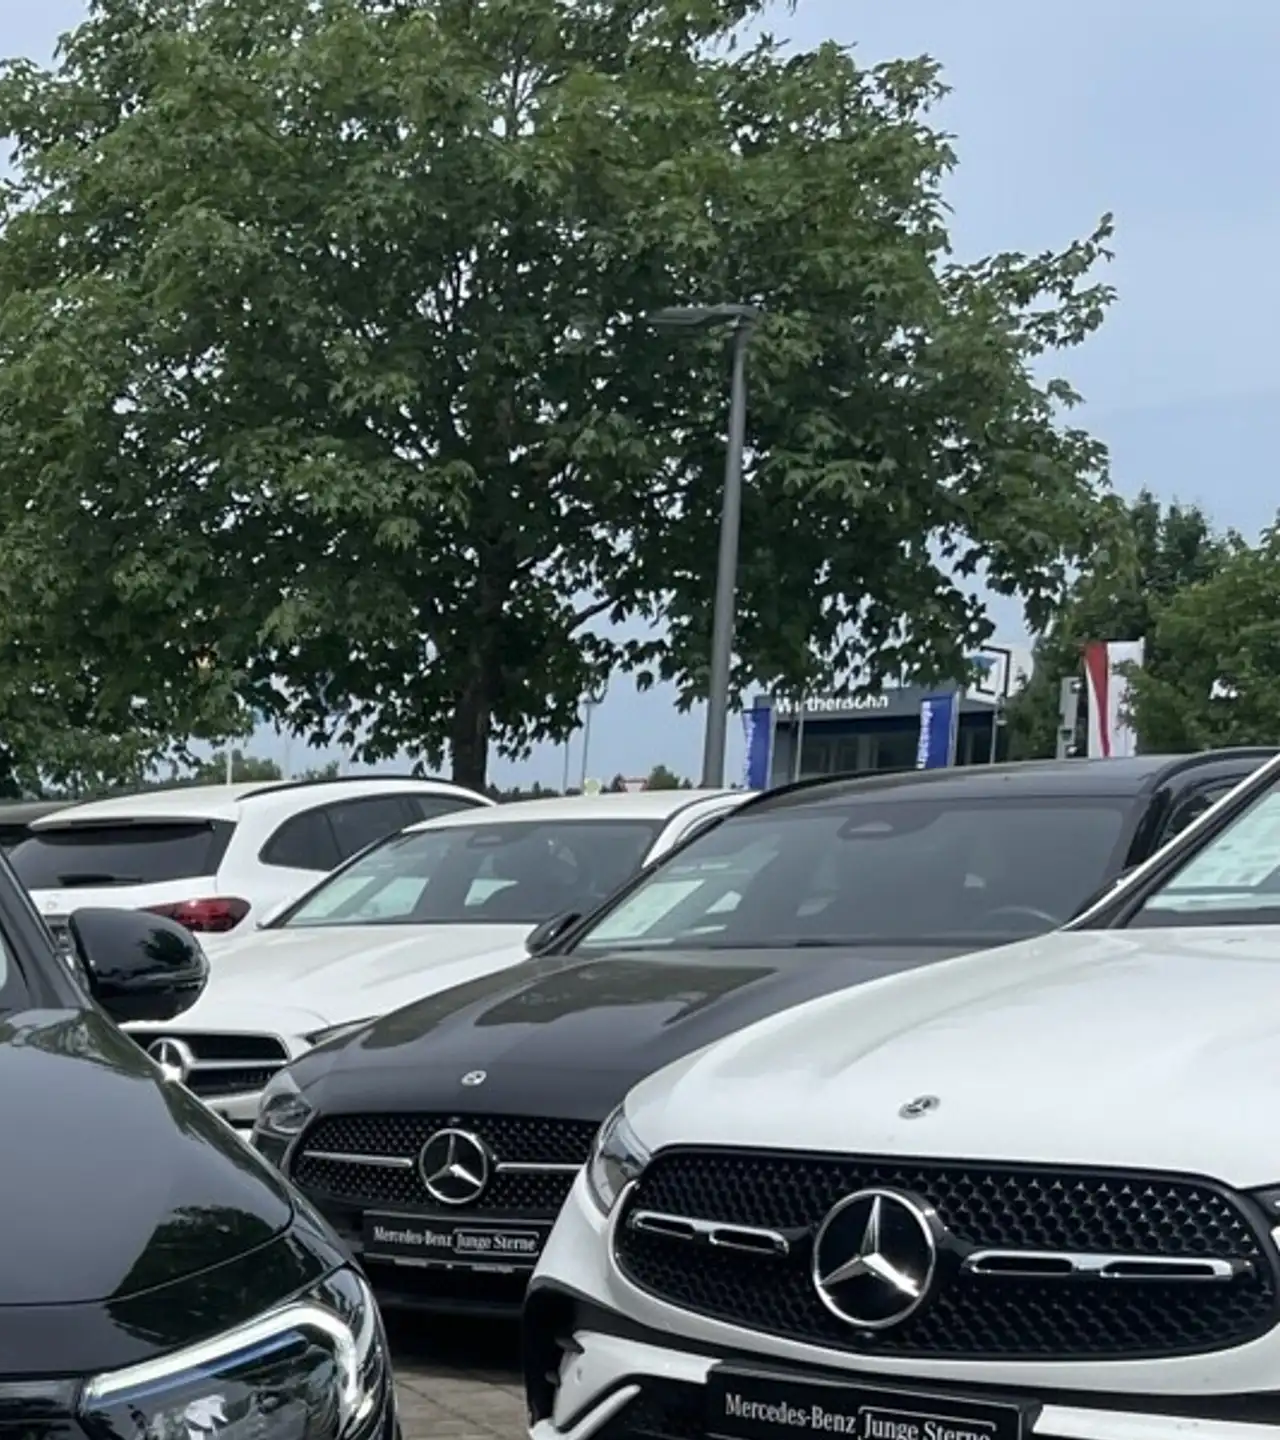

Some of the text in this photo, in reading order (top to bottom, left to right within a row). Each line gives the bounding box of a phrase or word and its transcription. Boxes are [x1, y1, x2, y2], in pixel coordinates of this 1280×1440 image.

[776, 694, 889, 714] Withensohn
[373, 1226, 536, 1251] Mercedes-Benz Junge Sterne
[725, 1393, 856, 1434] Mercedes-Benz
